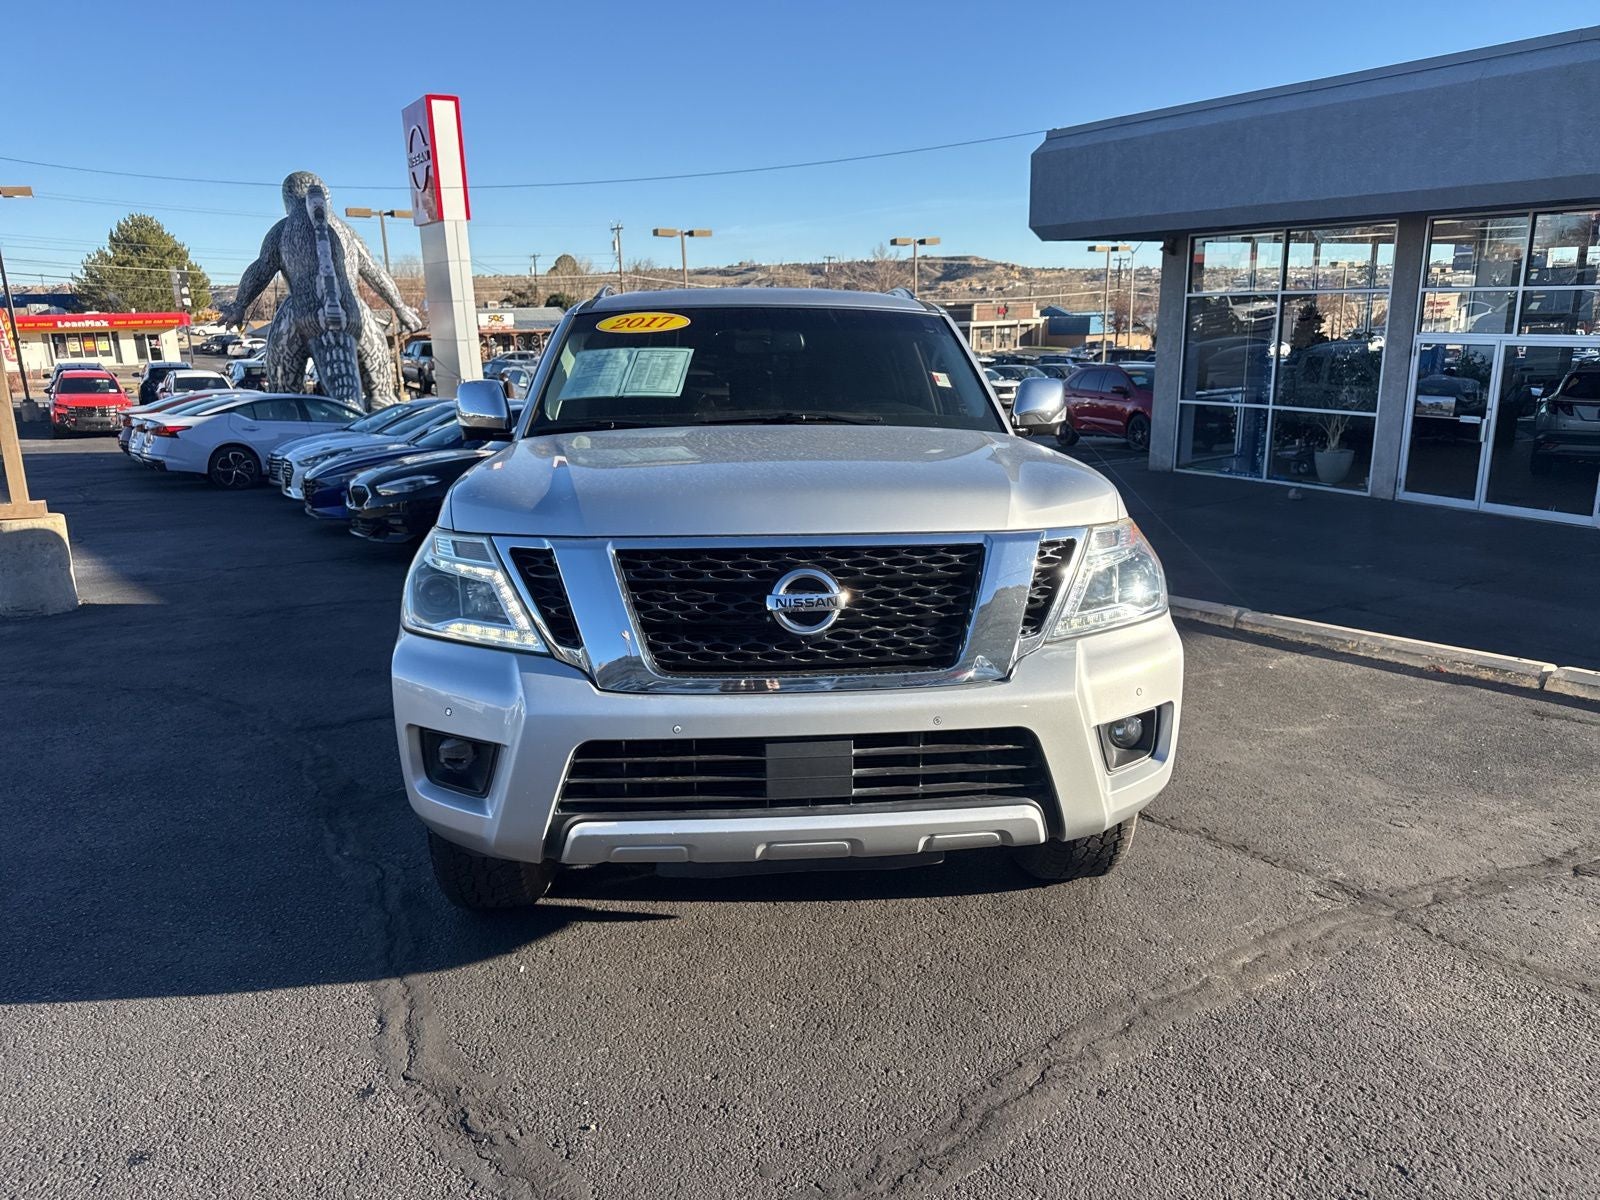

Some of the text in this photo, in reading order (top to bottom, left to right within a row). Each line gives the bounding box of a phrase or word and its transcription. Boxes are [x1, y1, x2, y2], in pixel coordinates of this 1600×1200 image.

[57, 320, 109, 328] LoanMax
[610, 316, 676, 330] 2017
[775, 597, 837, 608] NISSAN
